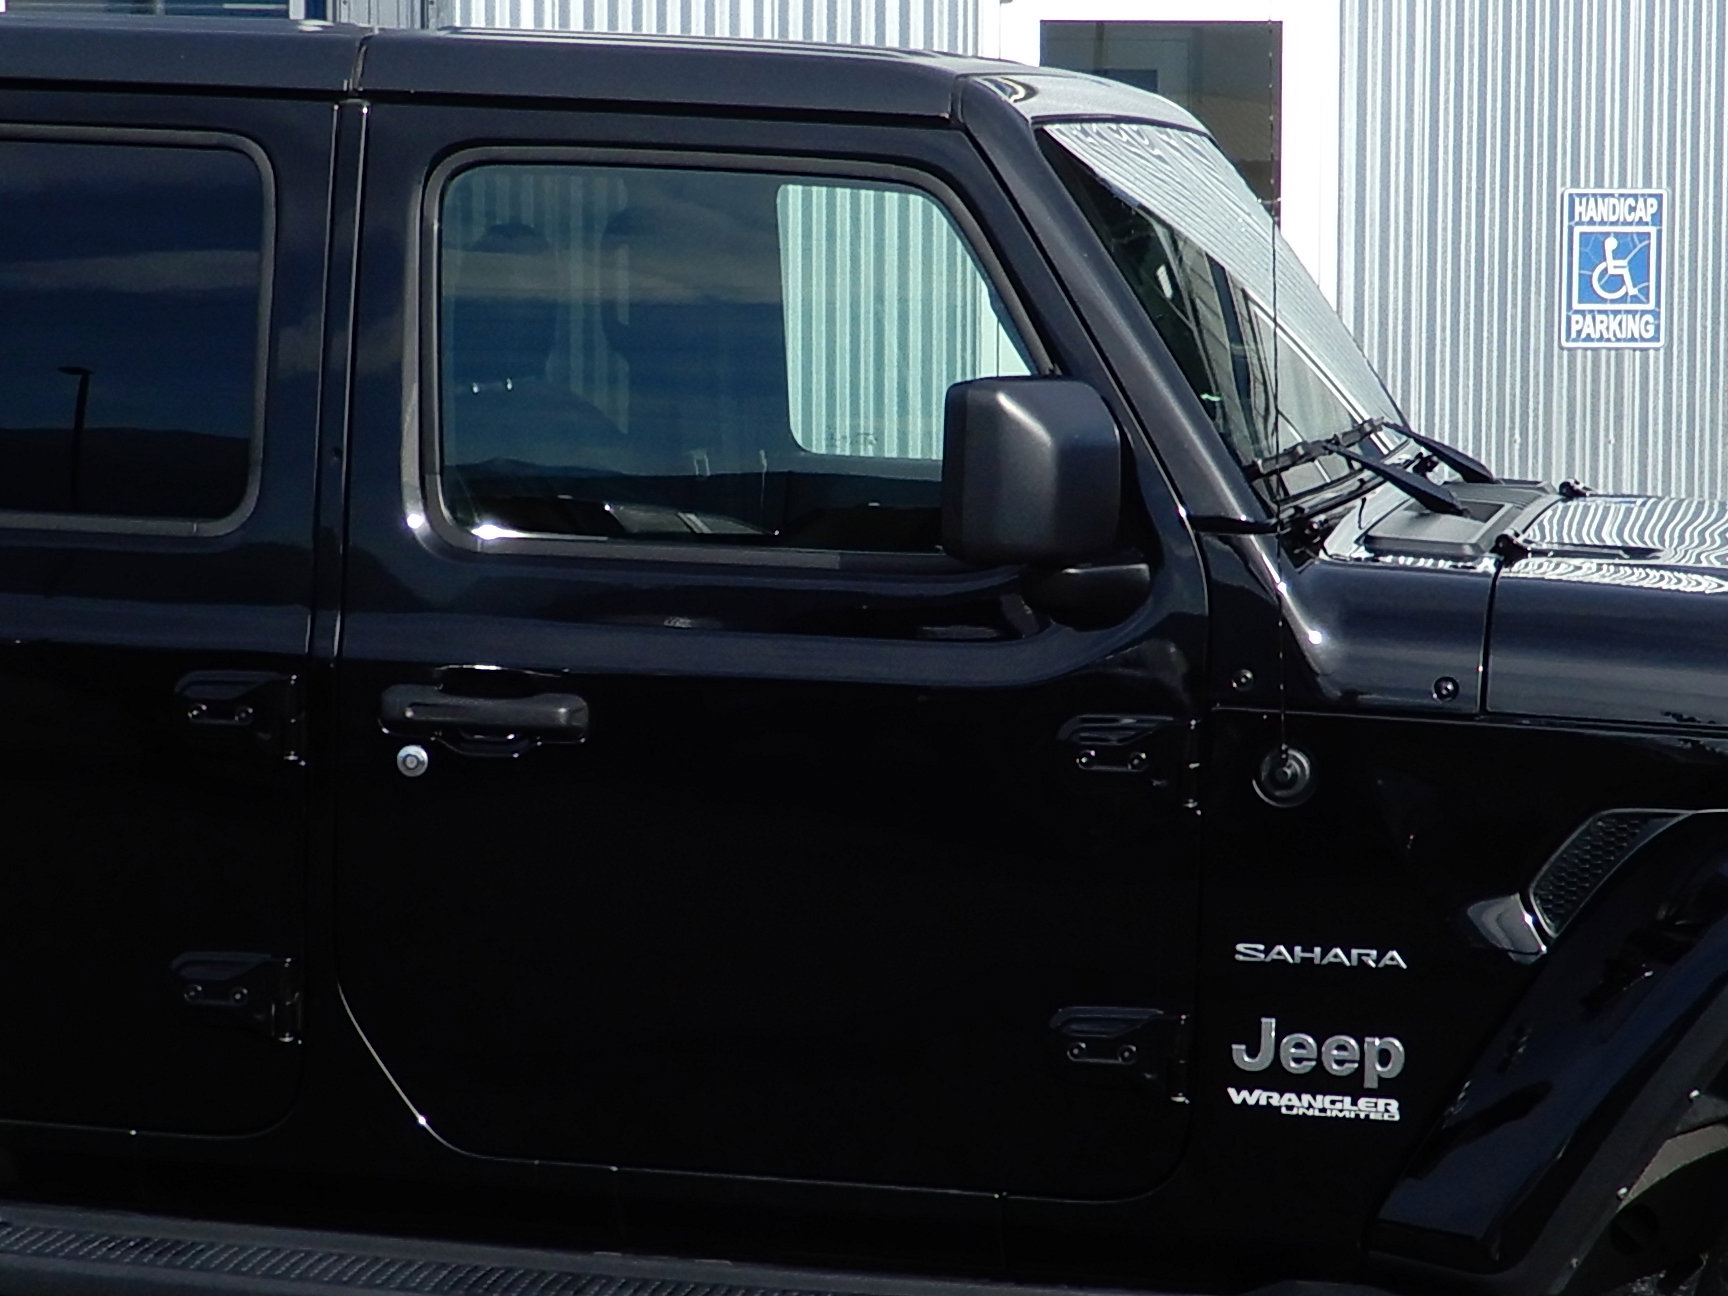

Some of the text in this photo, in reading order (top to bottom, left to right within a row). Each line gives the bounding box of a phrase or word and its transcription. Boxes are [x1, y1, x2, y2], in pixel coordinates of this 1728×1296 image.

[1573, 196, 1659, 223] HANDICAP
[1570, 313, 1656, 341] PARKING
[1233, 942, 1408, 969] SAHARA
[1230, 1016, 1406, 1089] Jeep
[1226, 1085, 1400, 1114] WRANGLER
[1280, 1105, 1401, 1122] UNLIMITED
